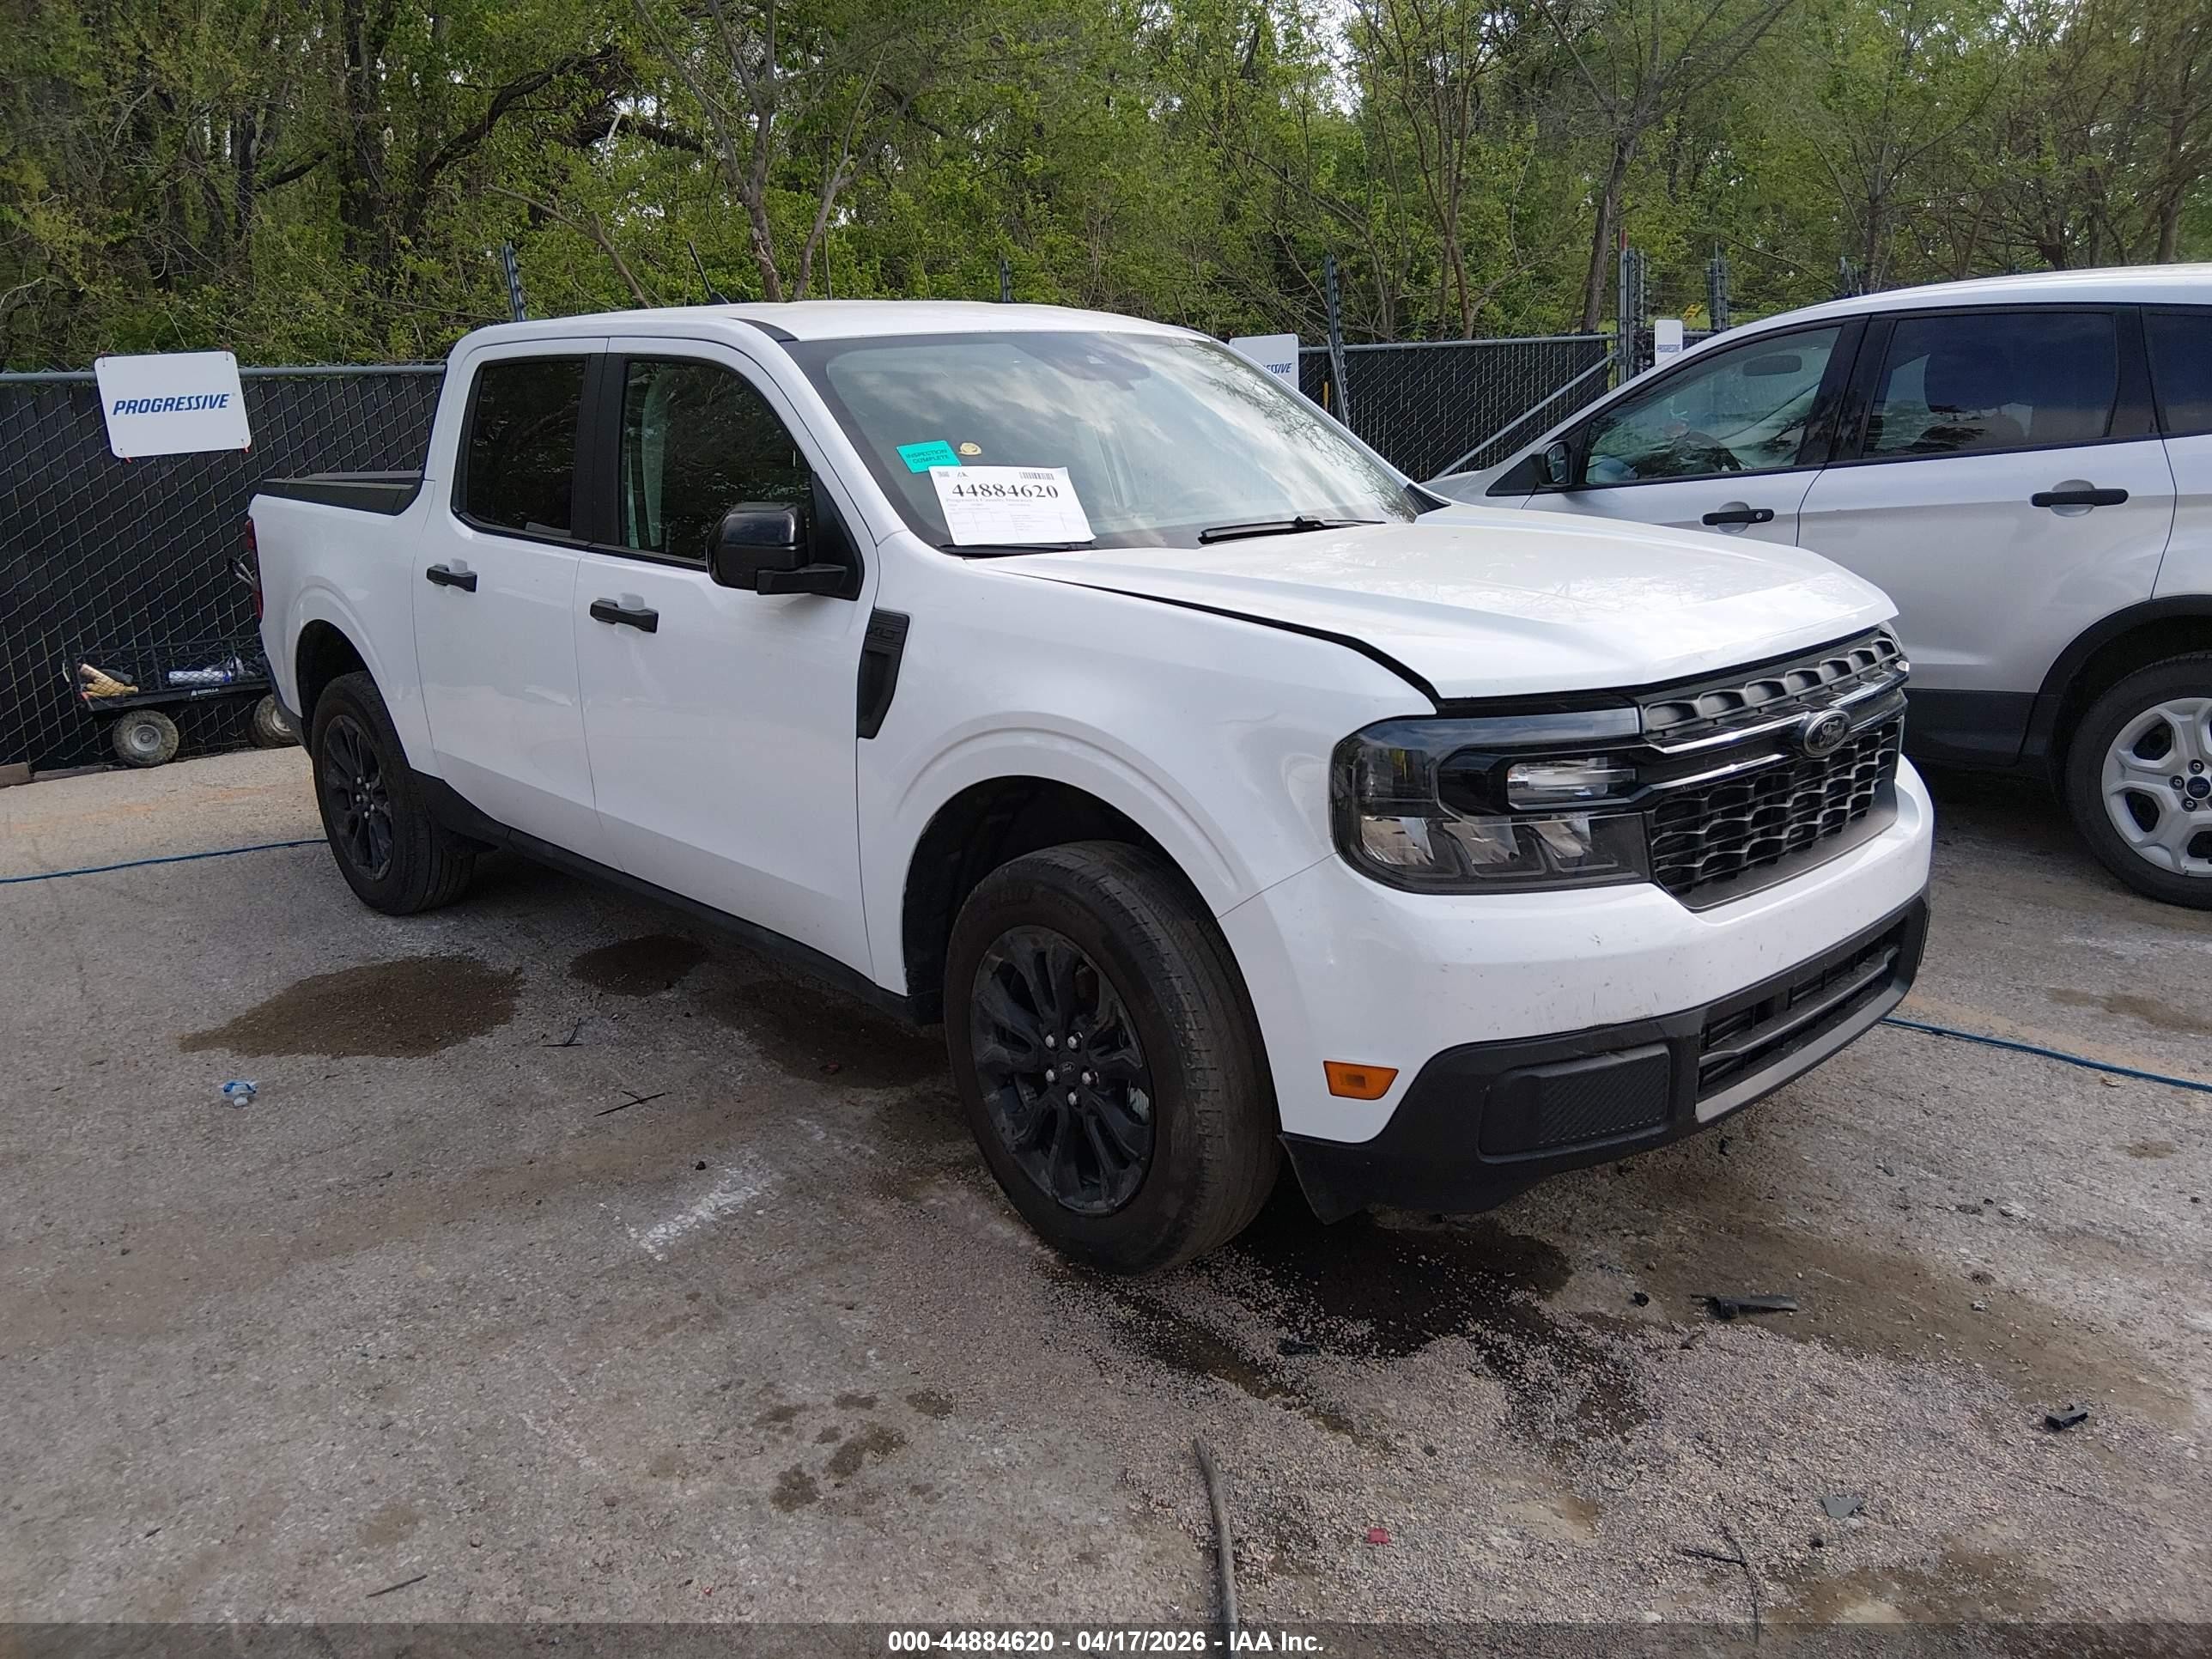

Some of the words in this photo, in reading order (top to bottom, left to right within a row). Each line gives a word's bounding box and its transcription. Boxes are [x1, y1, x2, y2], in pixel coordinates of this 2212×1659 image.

[1263, 362, 1291, 374] ESSIVE
[112, 393, 230, 416] PROGRESSIVE
[905, 449, 948, 459] INSPECTION
[912, 454, 949, 464] COMPLETE
[951, 483, 1059, 499] 44884620
